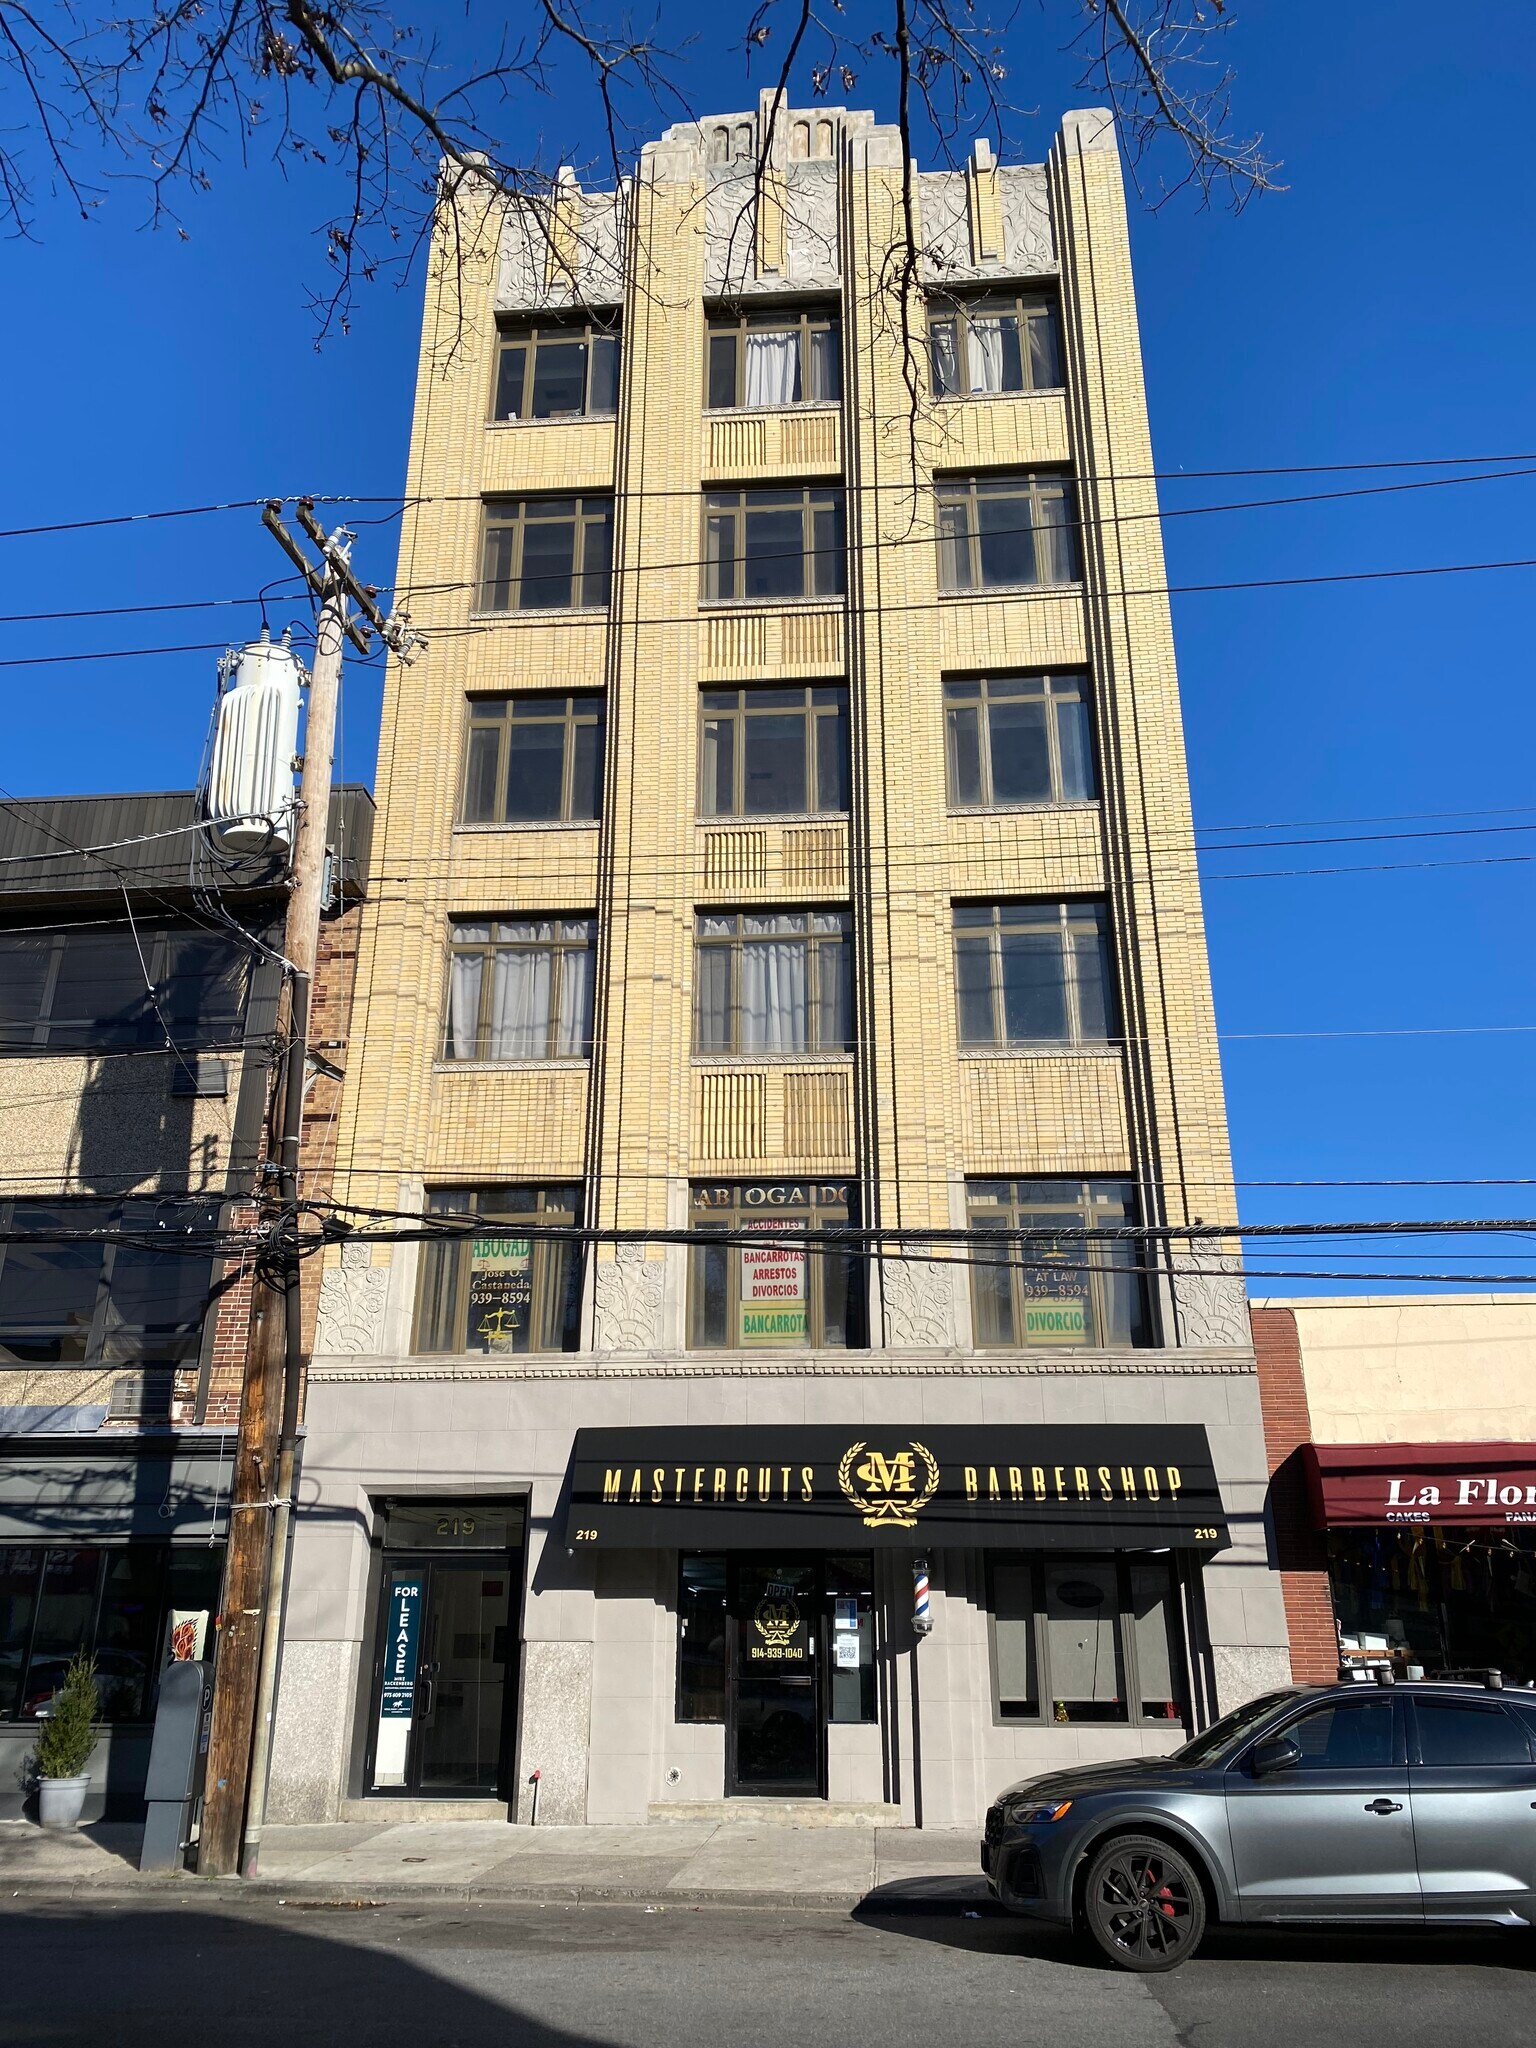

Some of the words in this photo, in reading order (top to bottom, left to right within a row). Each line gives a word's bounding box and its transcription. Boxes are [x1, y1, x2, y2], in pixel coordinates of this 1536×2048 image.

[748, 1218, 800, 1229] ACCIDENTES
[744, 1251, 805, 1264] BANCARROTAS
[753, 1267, 797, 1281] ARRESTOS
[1036, 1272, 1049, 1282] AT
[1053, 1271, 1078, 1282] LAW
[752, 1284, 798, 1297] DIVORCIOS
[1026, 1284, 1088, 1297] 939-8594
[471, 1292, 530, 1304] 939-8594
[602, 1467, 814, 1503] MASTERCUTS
[964, 1466, 1183, 1502] BARBERSHOP
[1384, 1479, 1441, 1506] La
[1386, 1512, 1431, 1522] CAKES
[436, 1518, 476, 1536] 219
[576, 1529, 598, 1541] 219
[1194, 1528, 1218, 1540] 219
[394, 1587, 418, 1597] FOR
[395, 1598, 411, 1674] LEASE
[751, 1647, 803, 1659] 914-939-1040
